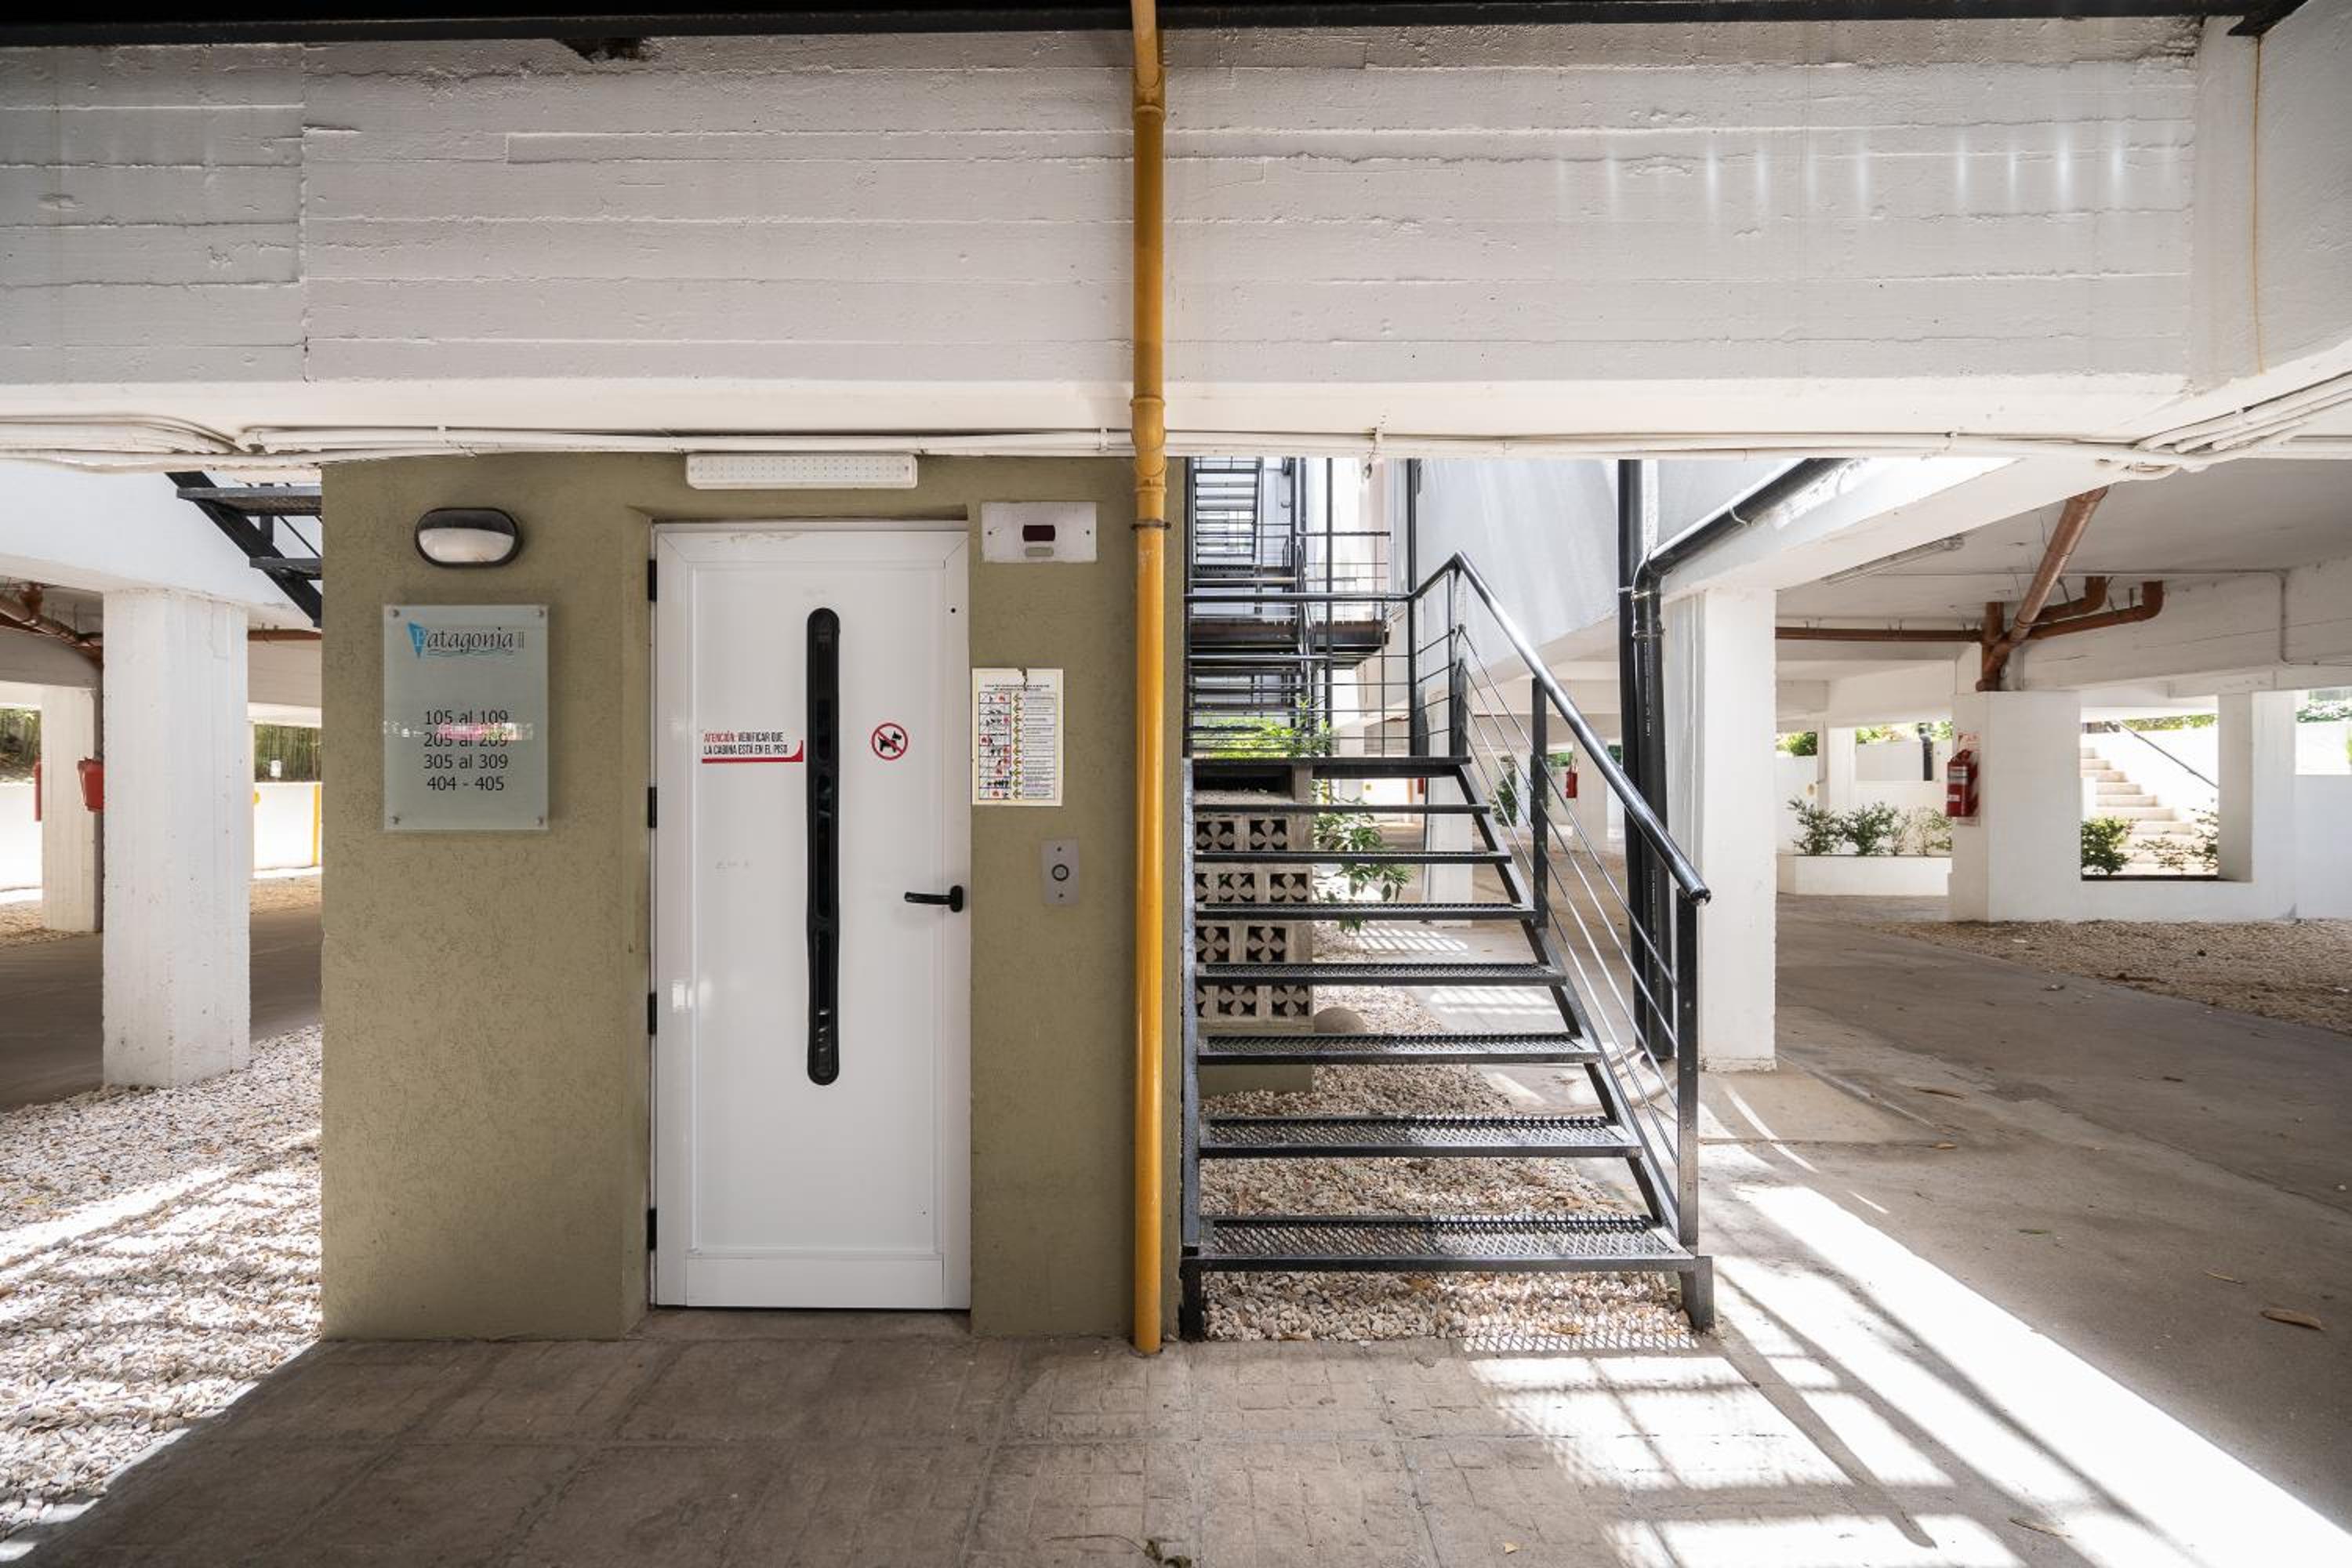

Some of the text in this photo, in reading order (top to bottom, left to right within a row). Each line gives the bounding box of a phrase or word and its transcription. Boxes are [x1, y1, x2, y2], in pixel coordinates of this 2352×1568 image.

[425, 710, 509, 724] 105 al 109
[424, 732, 509, 746] 205 al 209
[771, 731, 783, 742] QUE
[704, 744, 713, 754] LA
[755, 744, 764, 754] EN
[764, 744, 771, 754] EL
[424, 754, 509, 769] 305 al 309
[426, 775, 456, 790] 404
[474, 775, 504, 790] 405
